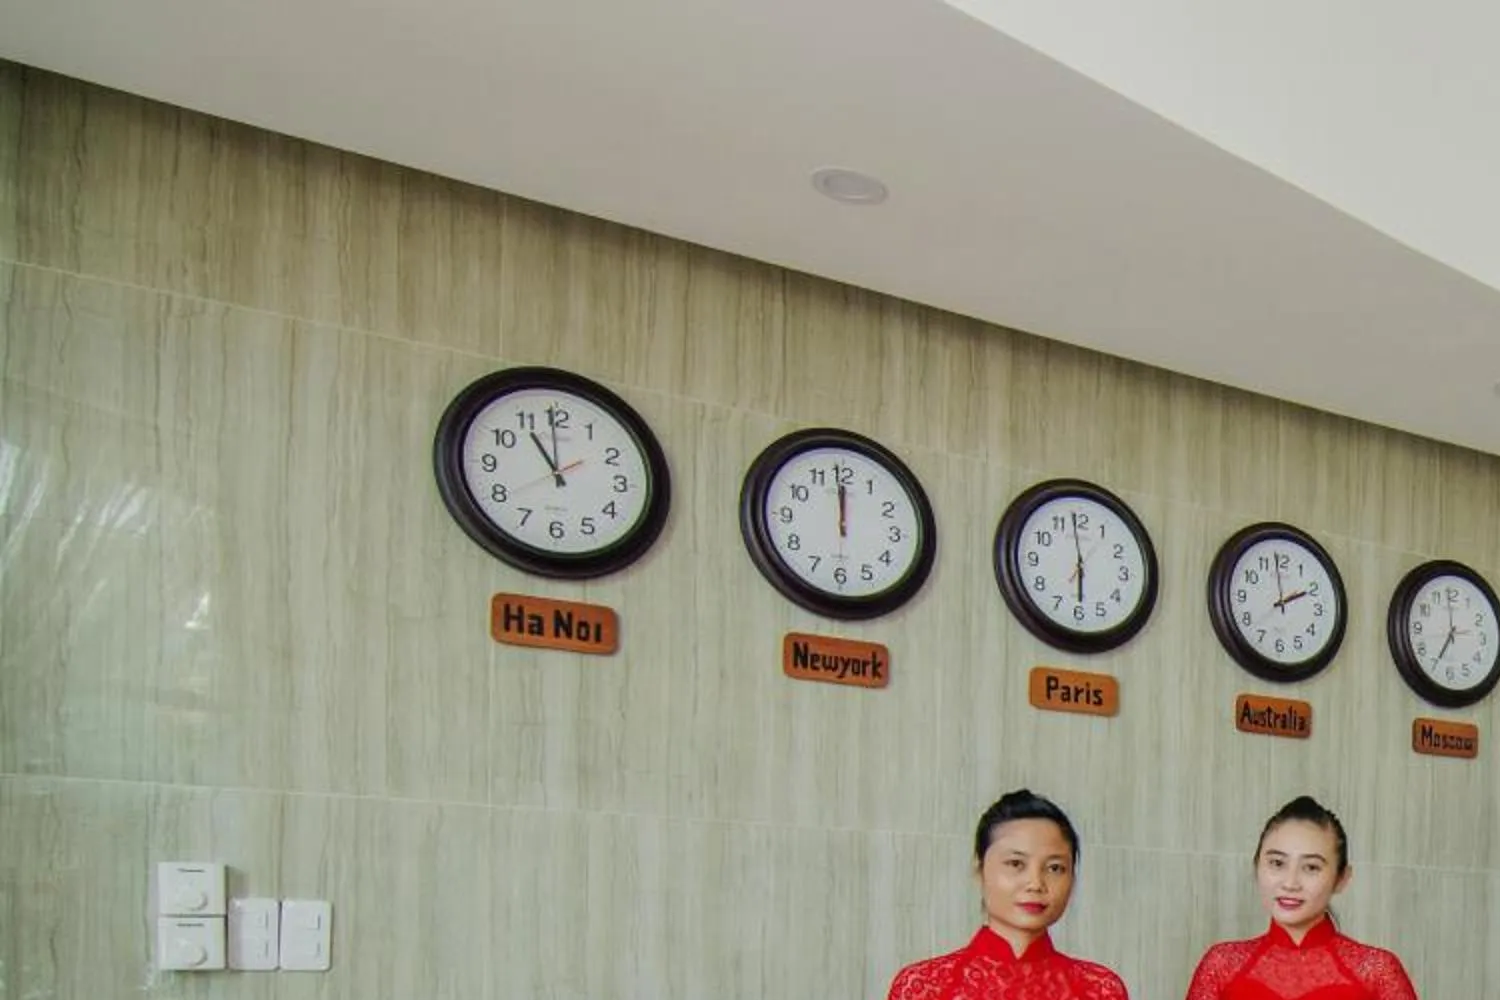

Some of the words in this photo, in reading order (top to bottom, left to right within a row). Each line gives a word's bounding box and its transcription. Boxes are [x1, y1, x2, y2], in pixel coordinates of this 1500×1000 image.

[515, 411, 535, 430] 11
[545, 409, 569, 428] 12
[492, 429, 516, 448] 10
[585, 423, 593, 440] 1
[481, 453, 497, 472] 9
[605, 447, 620, 466] 2
[613, 475, 628, 492] 3
[809, 468, 825, 486] 11
[832, 467, 854, 484] 12
[491, 483, 507, 503] 8
[790, 483, 809, 502] 10
[866, 480, 873, 495] 1
[517, 507, 532, 527] 7
[602, 501, 617, 519] 4
[780, 506, 793, 524] 9
[881, 501, 895, 518] 2
[549, 521, 565, 539] 6
[580, 517, 595, 535] 5
[1052, 515, 1065, 532] 11
[1099, 524, 1105, 539] 1
[787, 533, 800, 551] 8
[889, 526, 901, 543] 3
[1034, 530, 1052, 547] 10
[878, 550, 892, 567] 4
[1027, 551, 1039, 567] 9
[1113, 544, 1124, 559] 2
[808, 555, 822, 572] 7
[1258, 556, 1269, 571] 11
[1298, 563, 1303, 577] 1
[834, 567, 847, 584] 6
[861, 564, 873, 581] 5
[1118, 566, 1129, 581] 3
[1245, 569, 1259, 585] 10
[1034, 575, 1046, 592] 8
[1309, 581, 1319, 597] 2
[1052, 595, 1063, 611] 7
[1109, 588, 1121, 603] 4
[1237, 589, 1247, 603] 9
[1073, 605, 1085, 621] 6
[1095, 602, 1107, 617] 5
[1313, 602, 1323, 617] 3
[503, 603, 544, 636] Ha
[1242, 611, 1251, 626] 8
[1256, 629, 1266, 643] 7
[1306, 623, 1316, 636] 4
[1275, 638, 1285, 653] 6
[1293, 635, 1303, 649] 5
[793, 641, 882, 679] Newyork
[1046, 675, 1103, 706] Paris
[1240, 700, 1305, 731] Australia
